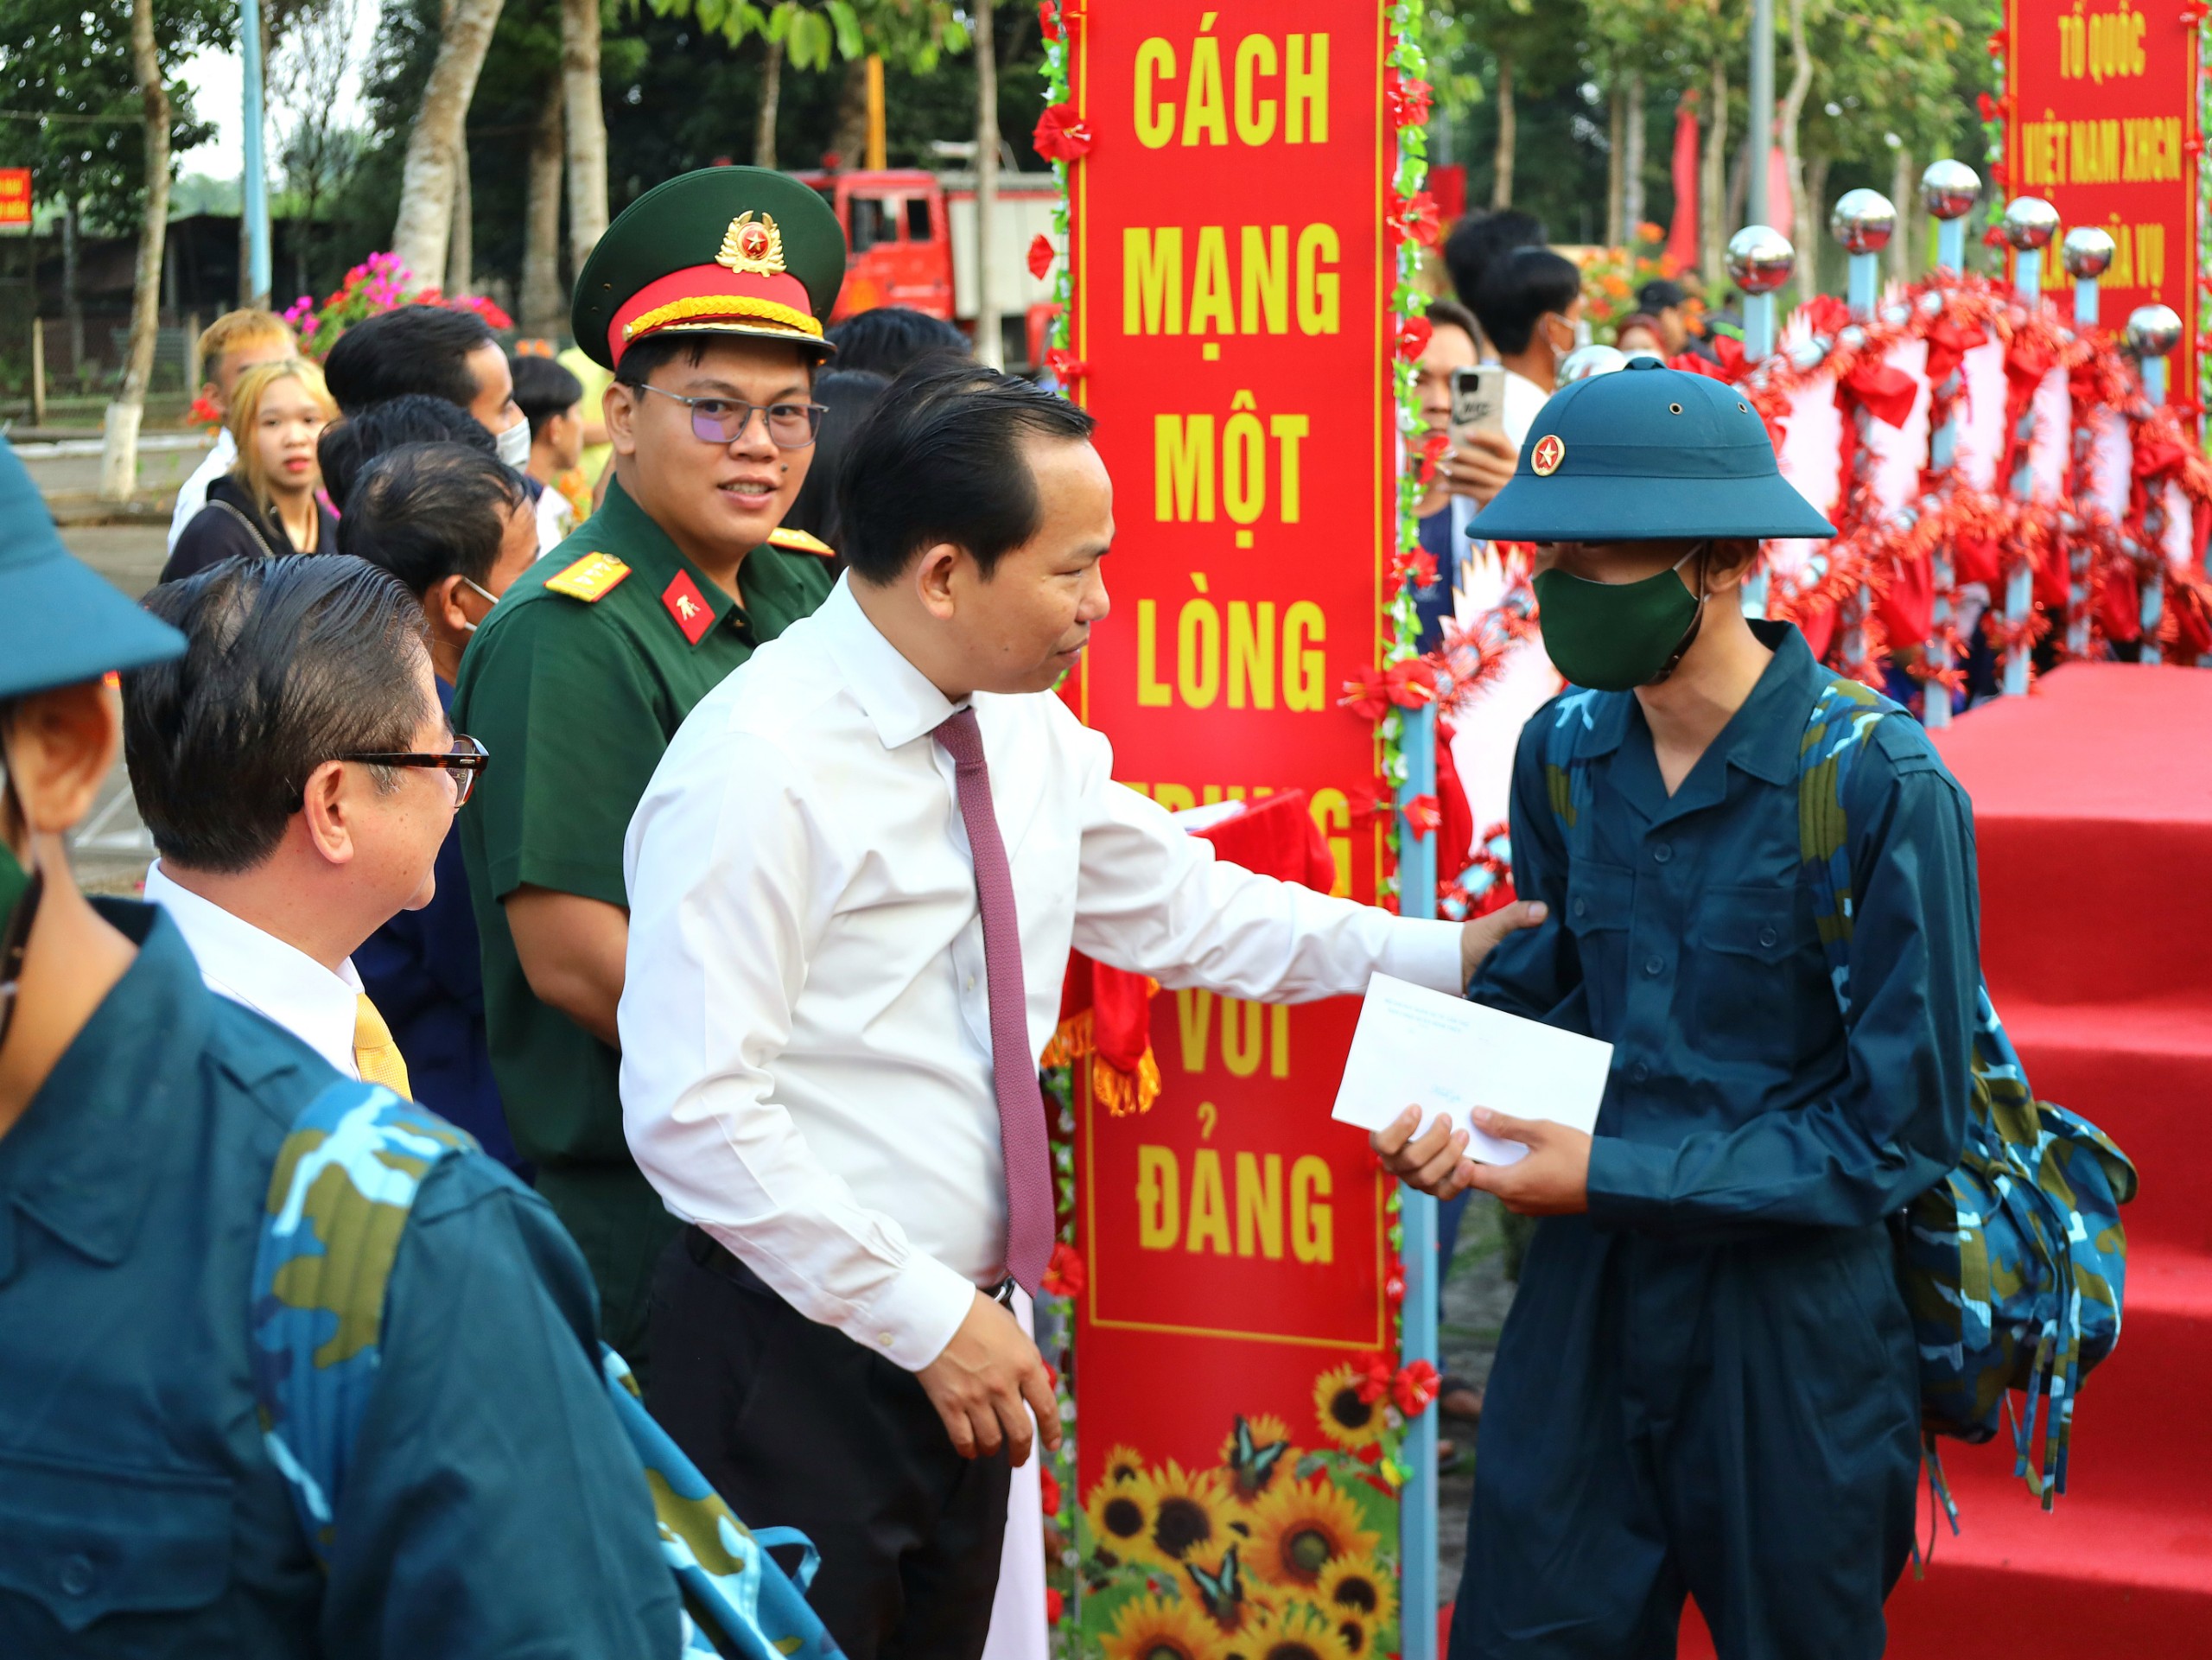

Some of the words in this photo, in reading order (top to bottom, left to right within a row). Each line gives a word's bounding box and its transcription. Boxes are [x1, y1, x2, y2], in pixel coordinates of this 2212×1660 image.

[1134, 12, 1330, 149] CÁCH
[2070, 119, 2120, 184] NAM
[2122, 116, 2182, 182] XHCN
[1123, 223, 1340, 360] MẠNG
[1154, 389, 1309, 549] MỘT
[1137, 572, 1326, 712] LÒNG
[1136, 1102, 1333, 1264] ĐẢNG
